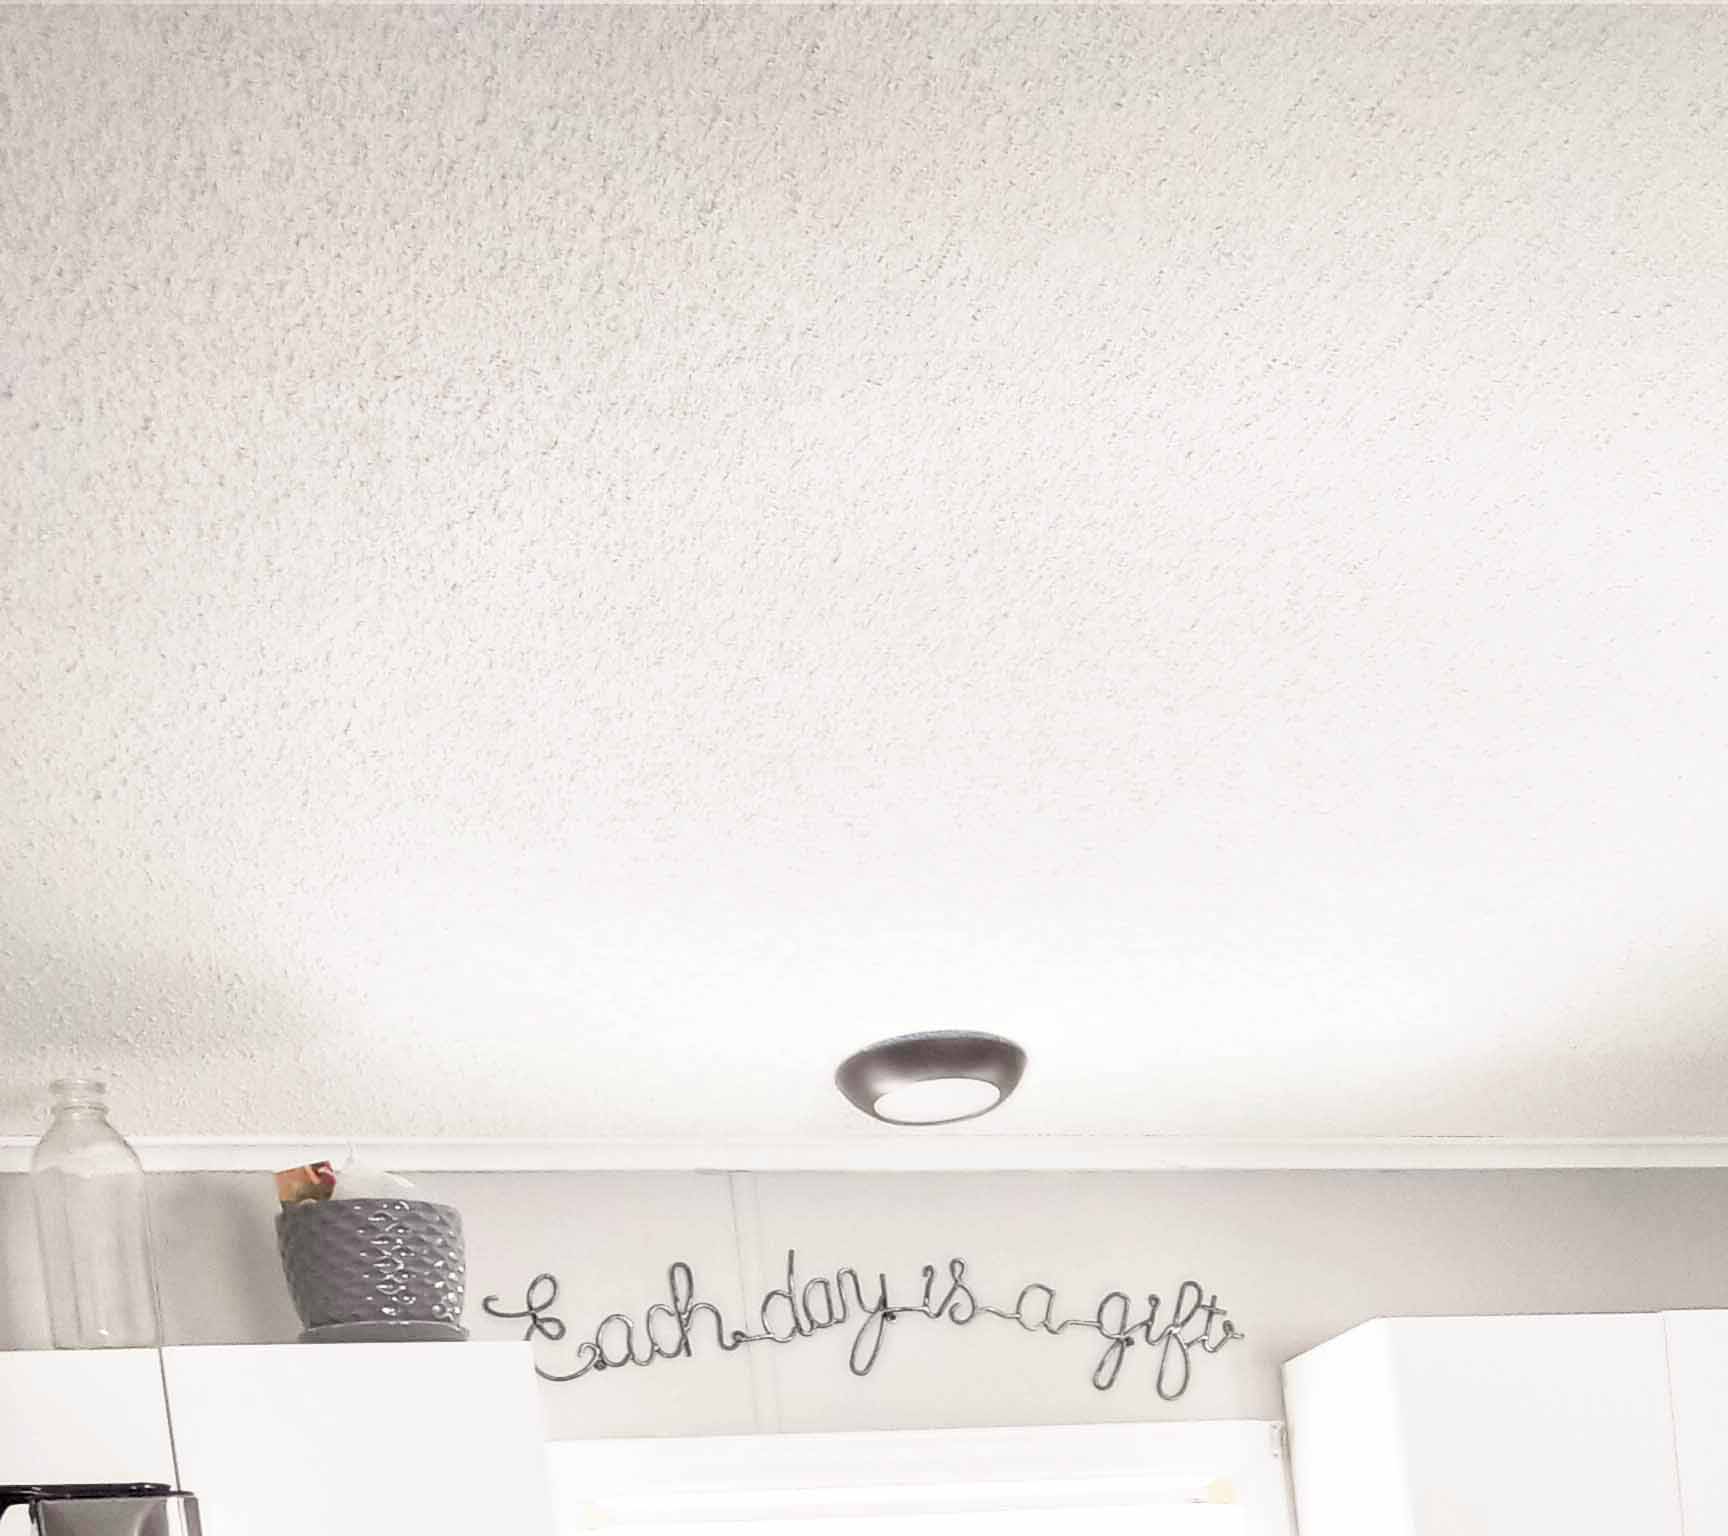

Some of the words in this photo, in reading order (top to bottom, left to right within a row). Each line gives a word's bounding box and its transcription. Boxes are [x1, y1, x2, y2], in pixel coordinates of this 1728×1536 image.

[482, 1262, 738, 1382] Each
[761, 1249, 890, 1376] day
[922, 1257, 977, 1326] is
[1015, 1283, 1062, 1335] a
[1093, 1280, 1244, 1401] gift
